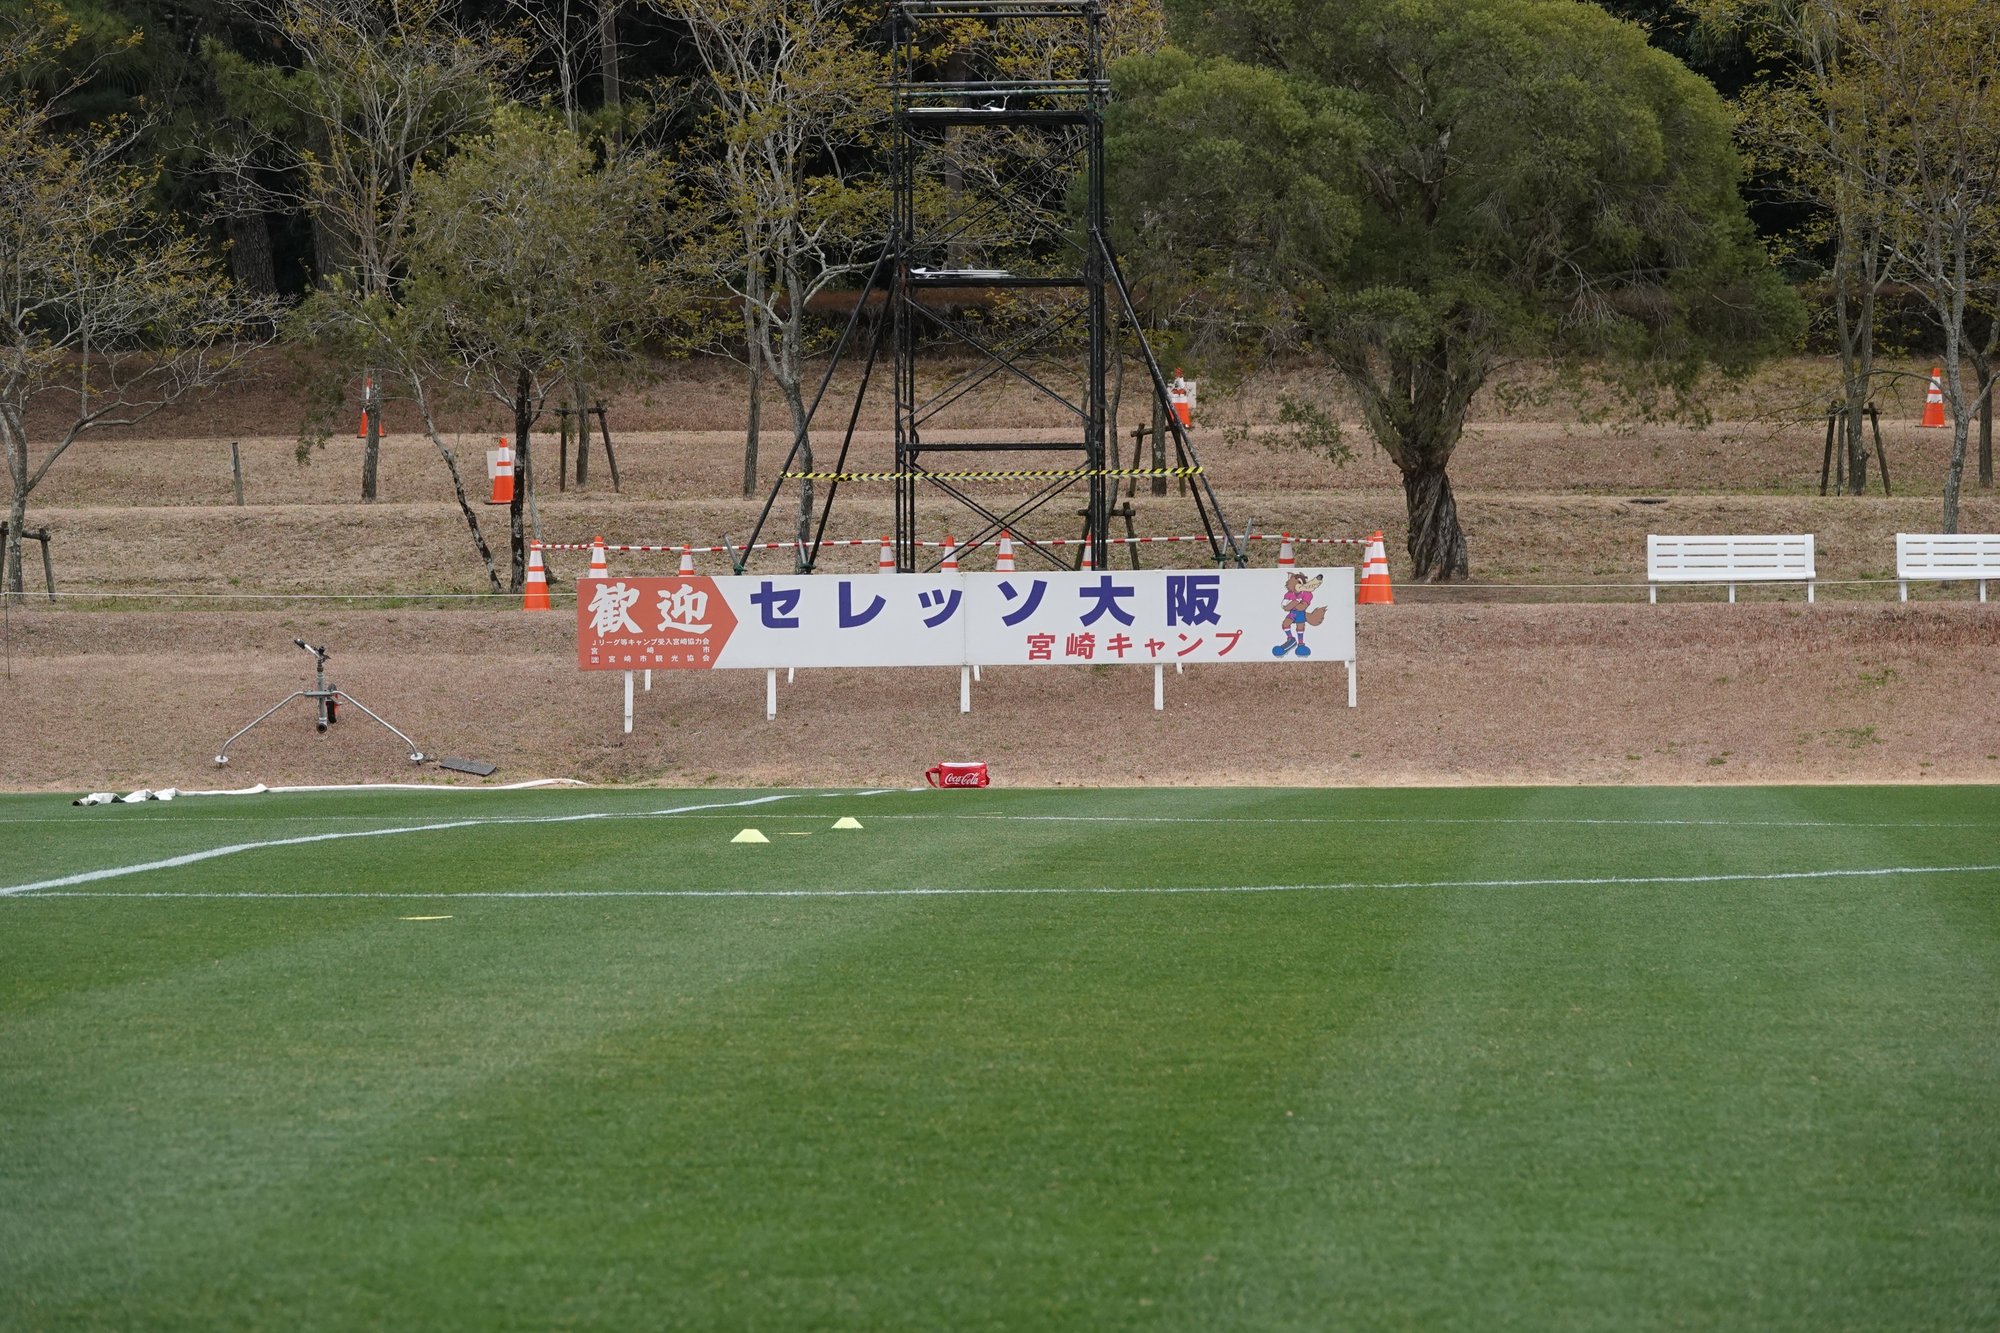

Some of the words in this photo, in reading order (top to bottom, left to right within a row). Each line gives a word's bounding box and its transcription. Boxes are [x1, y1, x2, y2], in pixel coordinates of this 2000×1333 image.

[588, 582, 713, 637] 歓迎
[750, 575, 1222, 629] セレッソ大阪
[1027, 629, 1243, 660] 宮崎キャンプ
